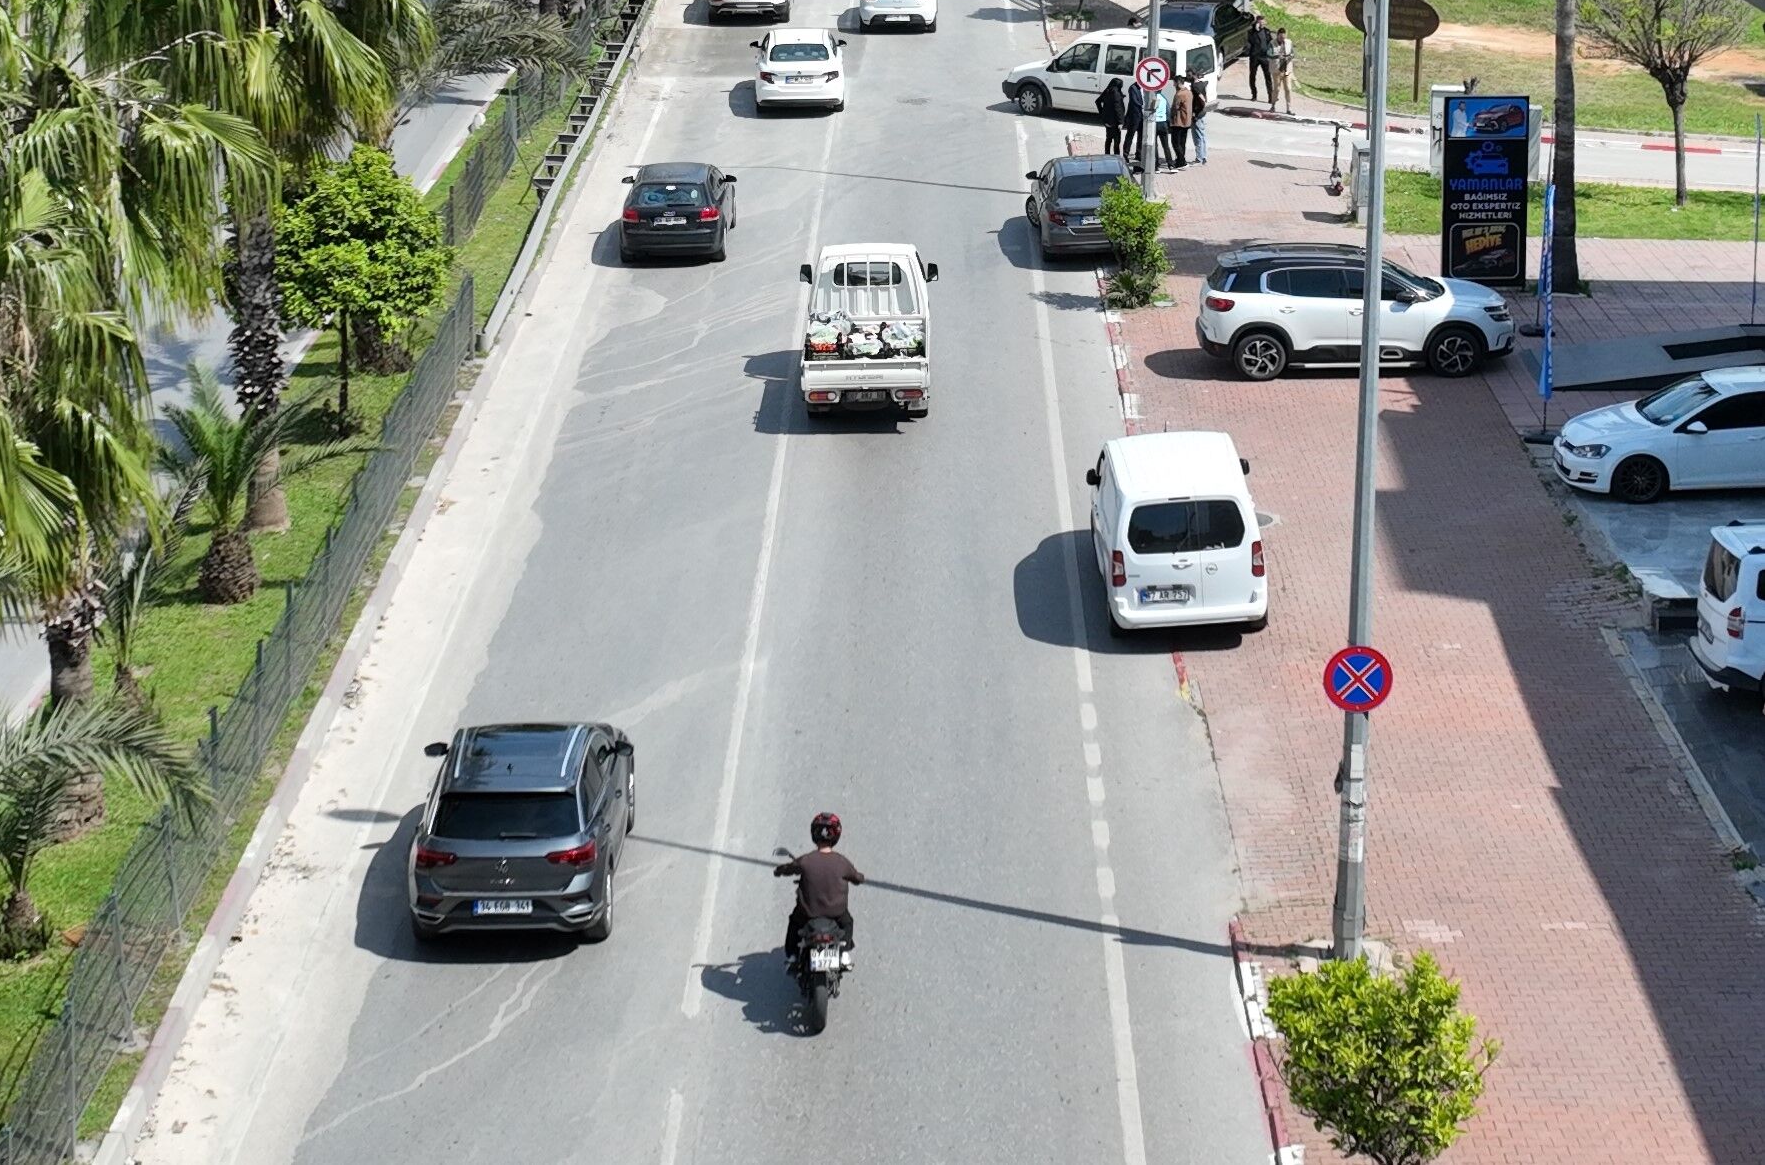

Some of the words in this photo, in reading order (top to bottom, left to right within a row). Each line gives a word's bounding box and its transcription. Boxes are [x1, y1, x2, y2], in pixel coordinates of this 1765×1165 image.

[1450, 178, 1523, 191] YAMANLAR
[1464, 192, 1508, 201] BAĞIMSIZ
[1450, 202, 1470, 210] OTO
